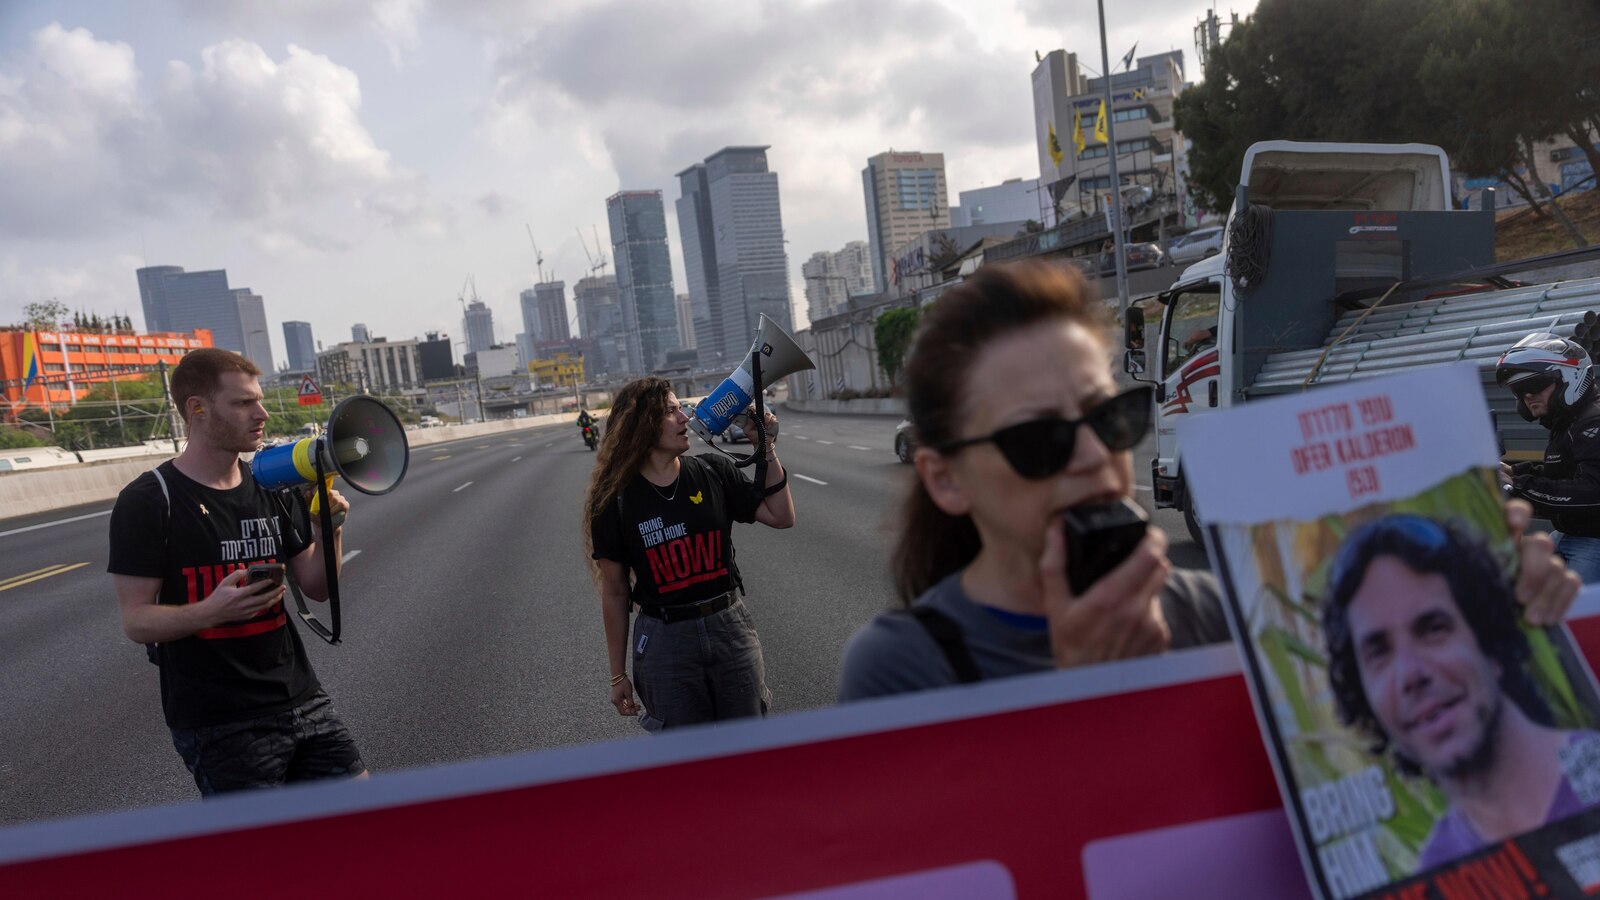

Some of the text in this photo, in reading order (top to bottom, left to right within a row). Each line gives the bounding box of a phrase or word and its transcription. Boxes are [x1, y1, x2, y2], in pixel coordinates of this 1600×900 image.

[892, 153, 924, 163] TOYOTA
[1290, 422, 1415, 476] OFER KALDERON
[638, 516, 664, 535] BRING
[642, 522, 688, 548] THEM HOME
[220, 538, 258, 561] הביתה
[645, 529, 722, 585] NOW!
[1301, 765, 1397, 845] BRING
[1317, 831, 1391, 900] HIM
